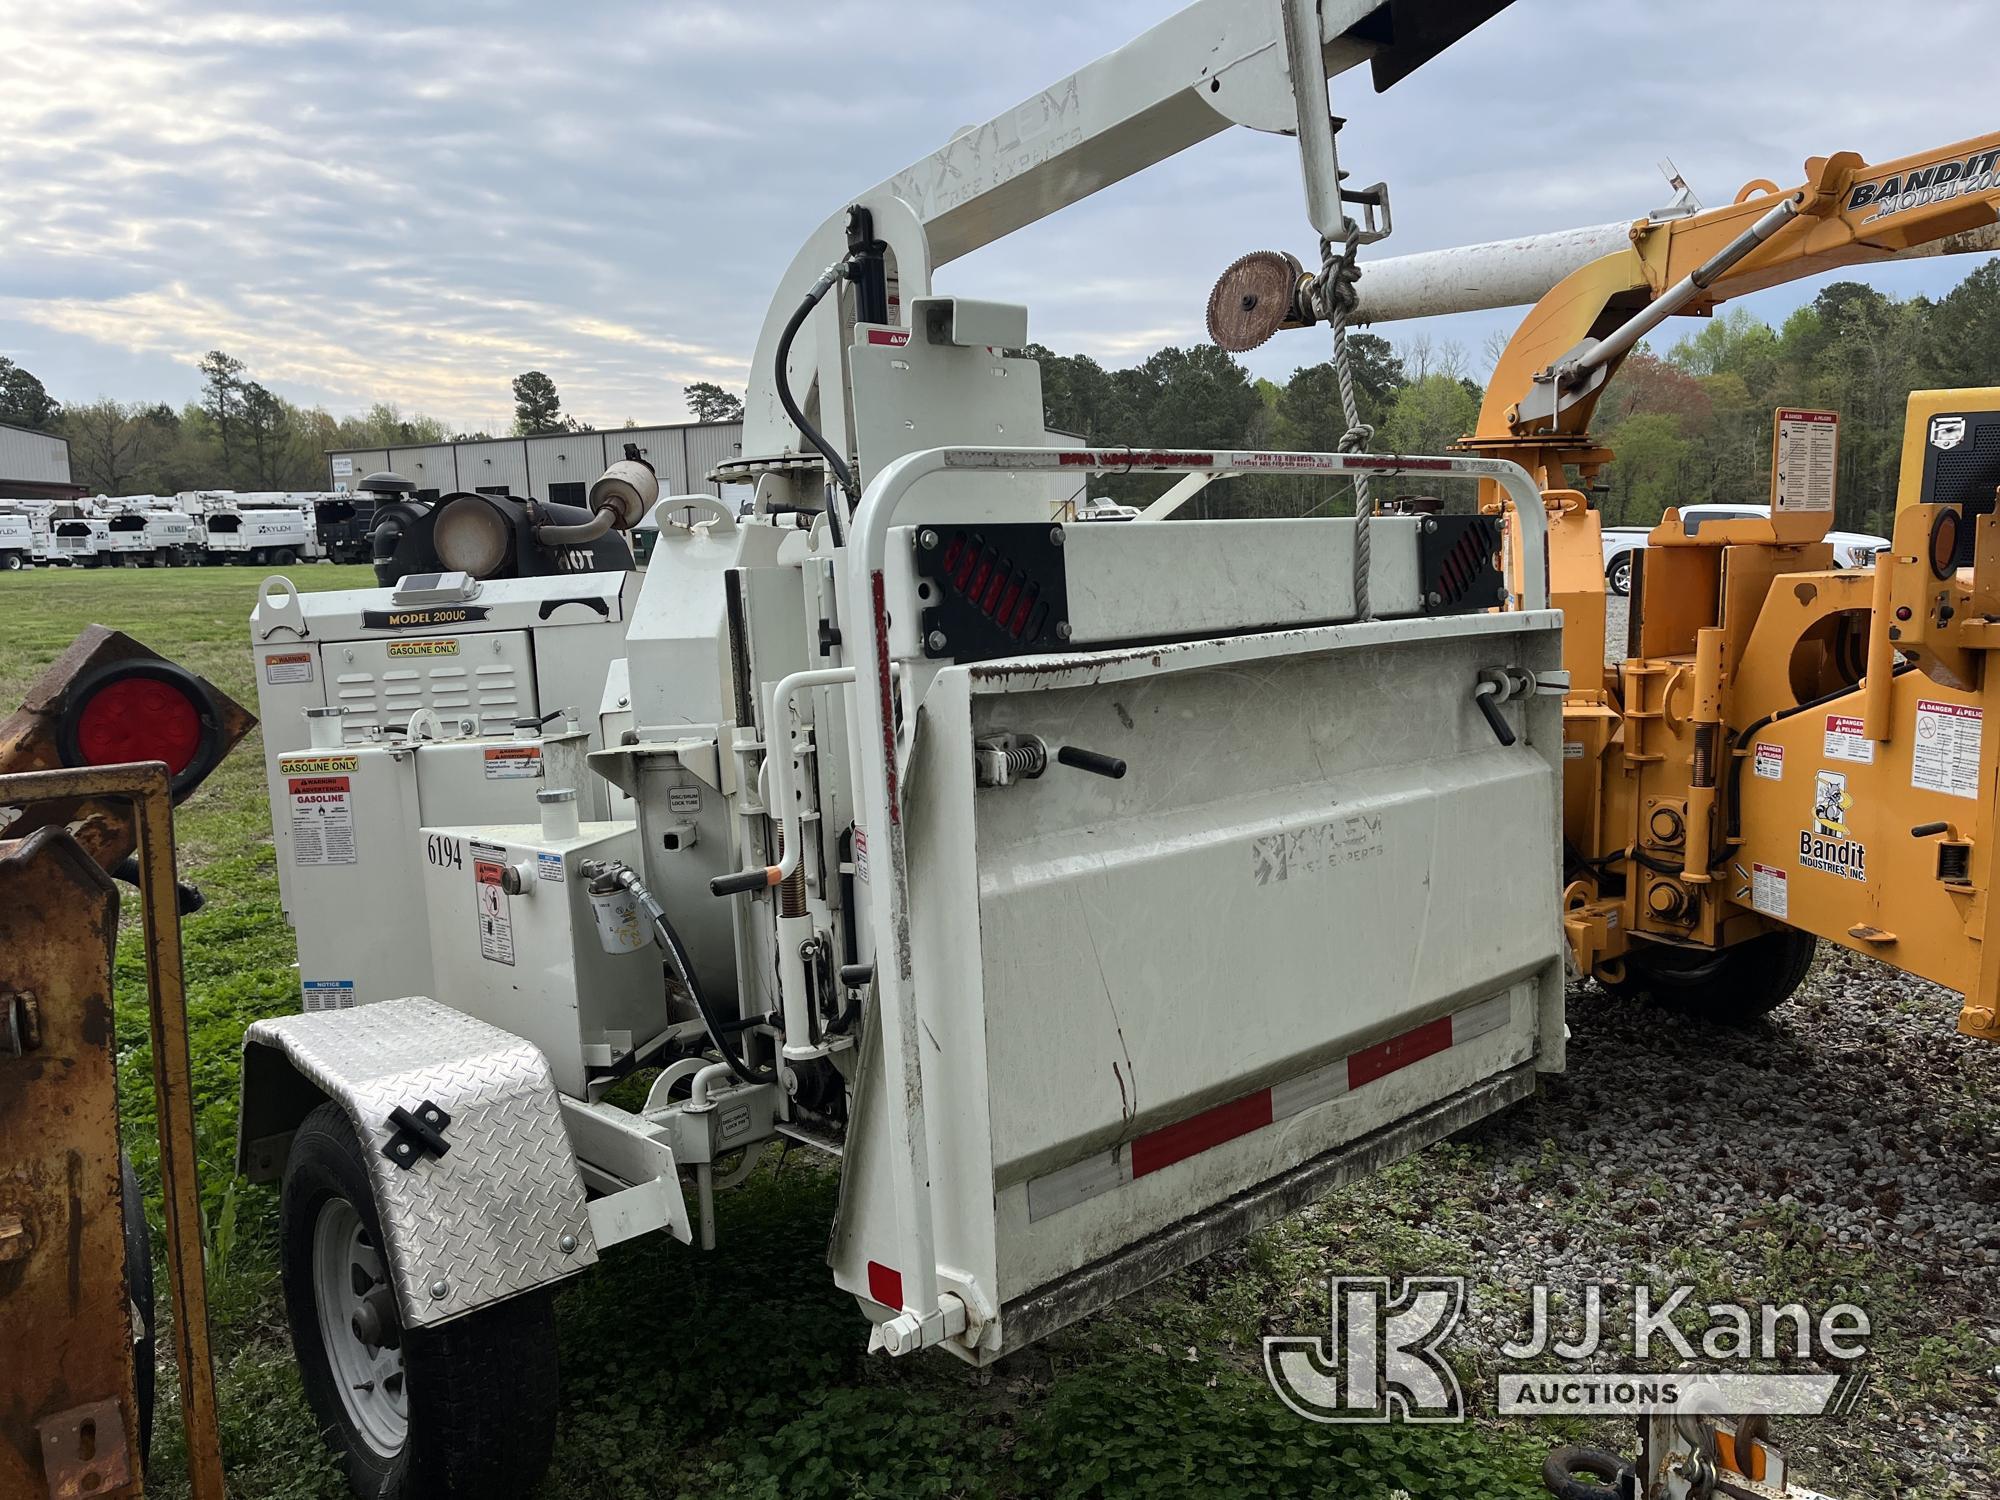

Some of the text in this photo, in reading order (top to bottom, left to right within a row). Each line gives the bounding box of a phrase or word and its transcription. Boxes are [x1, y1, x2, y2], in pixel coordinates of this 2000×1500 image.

[1847, 149, 2000, 211] BANDIT
[1877, 180, 1959, 217] MODEL
[389, 610, 466, 625] MODEL 200UC
[390, 645, 457, 656] GASOLINE ONLY
[1926, 705, 1953, 713] DANGER
[281, 761, 357, 773] GASOLINE ONLY
[297, 794, 344, 804] GASOLINE
[428, 834, 462, 871] 6194
[1800, 831, 1865, 870] Bandit
[1800, 855, 1866, 881] INDUSTRIES, INC.
